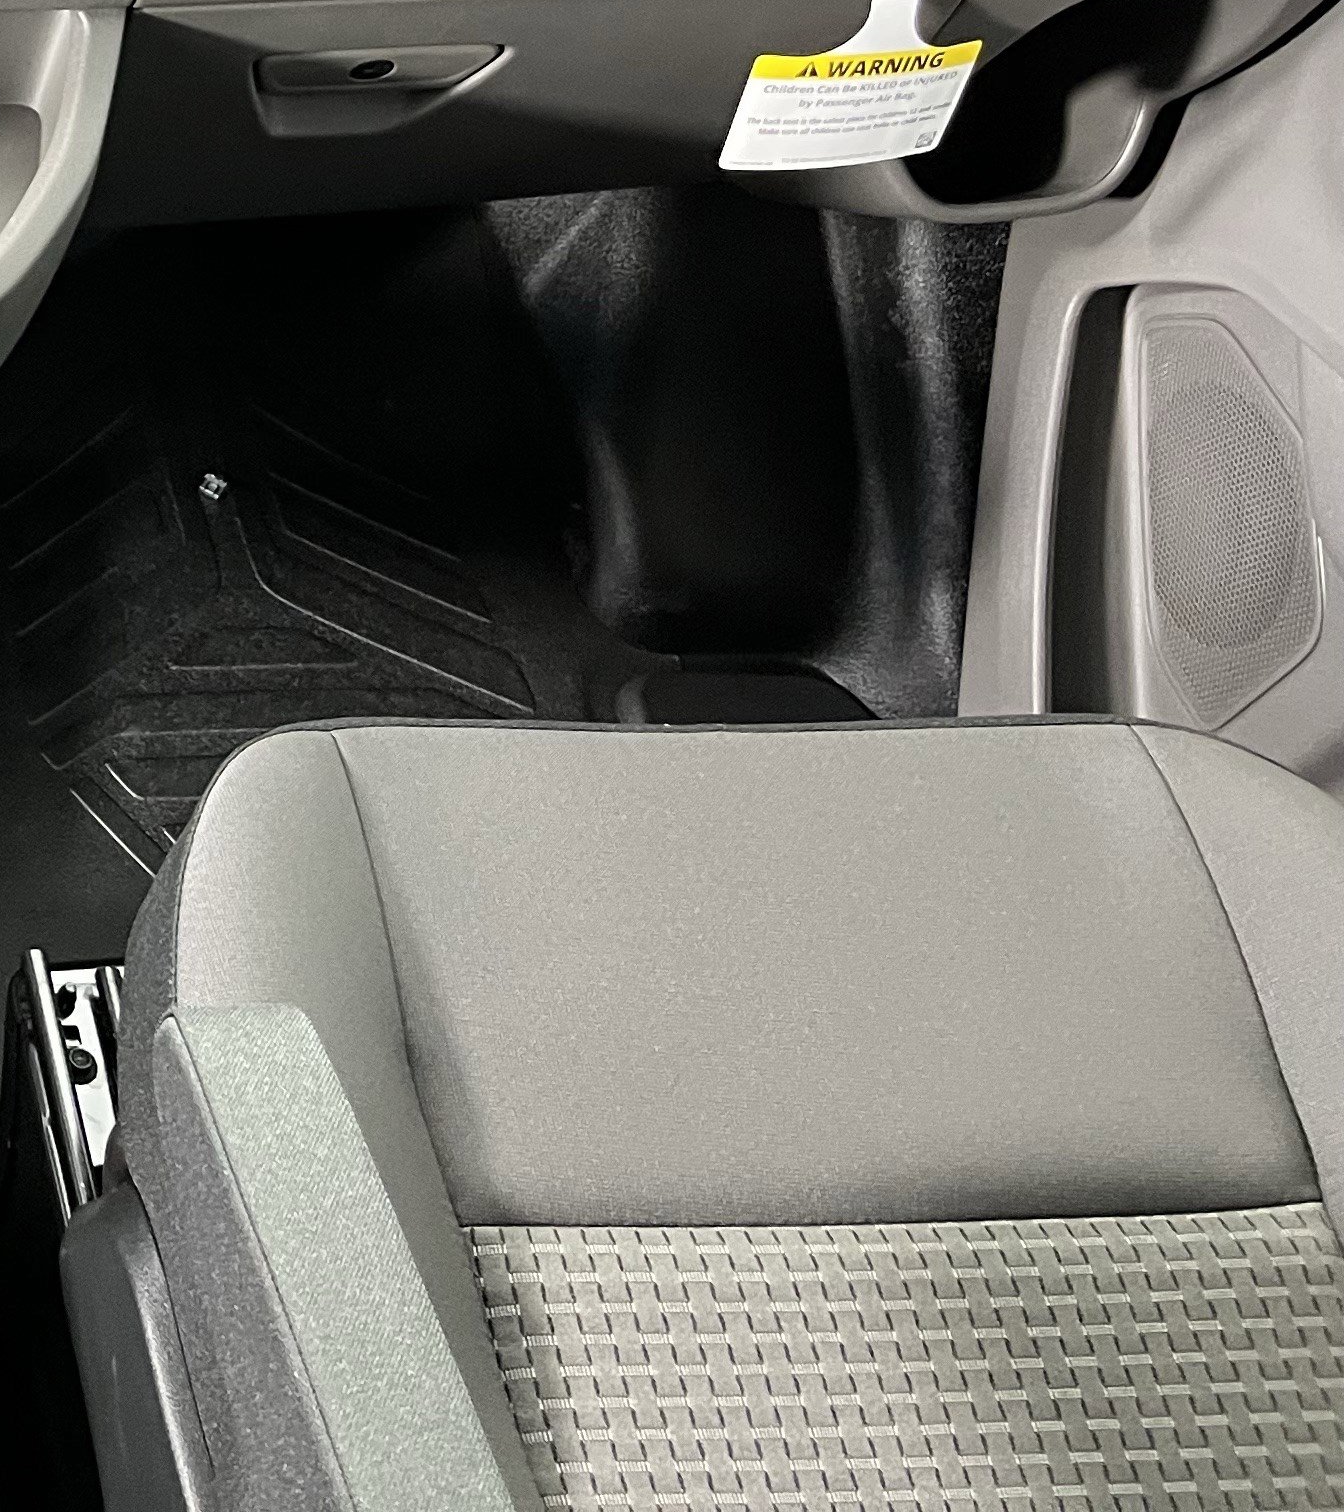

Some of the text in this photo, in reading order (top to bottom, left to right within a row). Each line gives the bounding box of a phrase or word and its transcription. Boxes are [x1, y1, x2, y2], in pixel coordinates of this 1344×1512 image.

[827, 51, 946, 78] WARNING
[763, 84, 814, 94] Children
[817, 85, 840, 94] Can
[842, 84, 857, 93] Be
[859, 80, 898, 92] KILLED
[914, 71, 958, 86] INJURED
[798, 99, 813, 109] by
[816, 96, 874, 108] Passenger
[875, 94, 892, 103] Air
